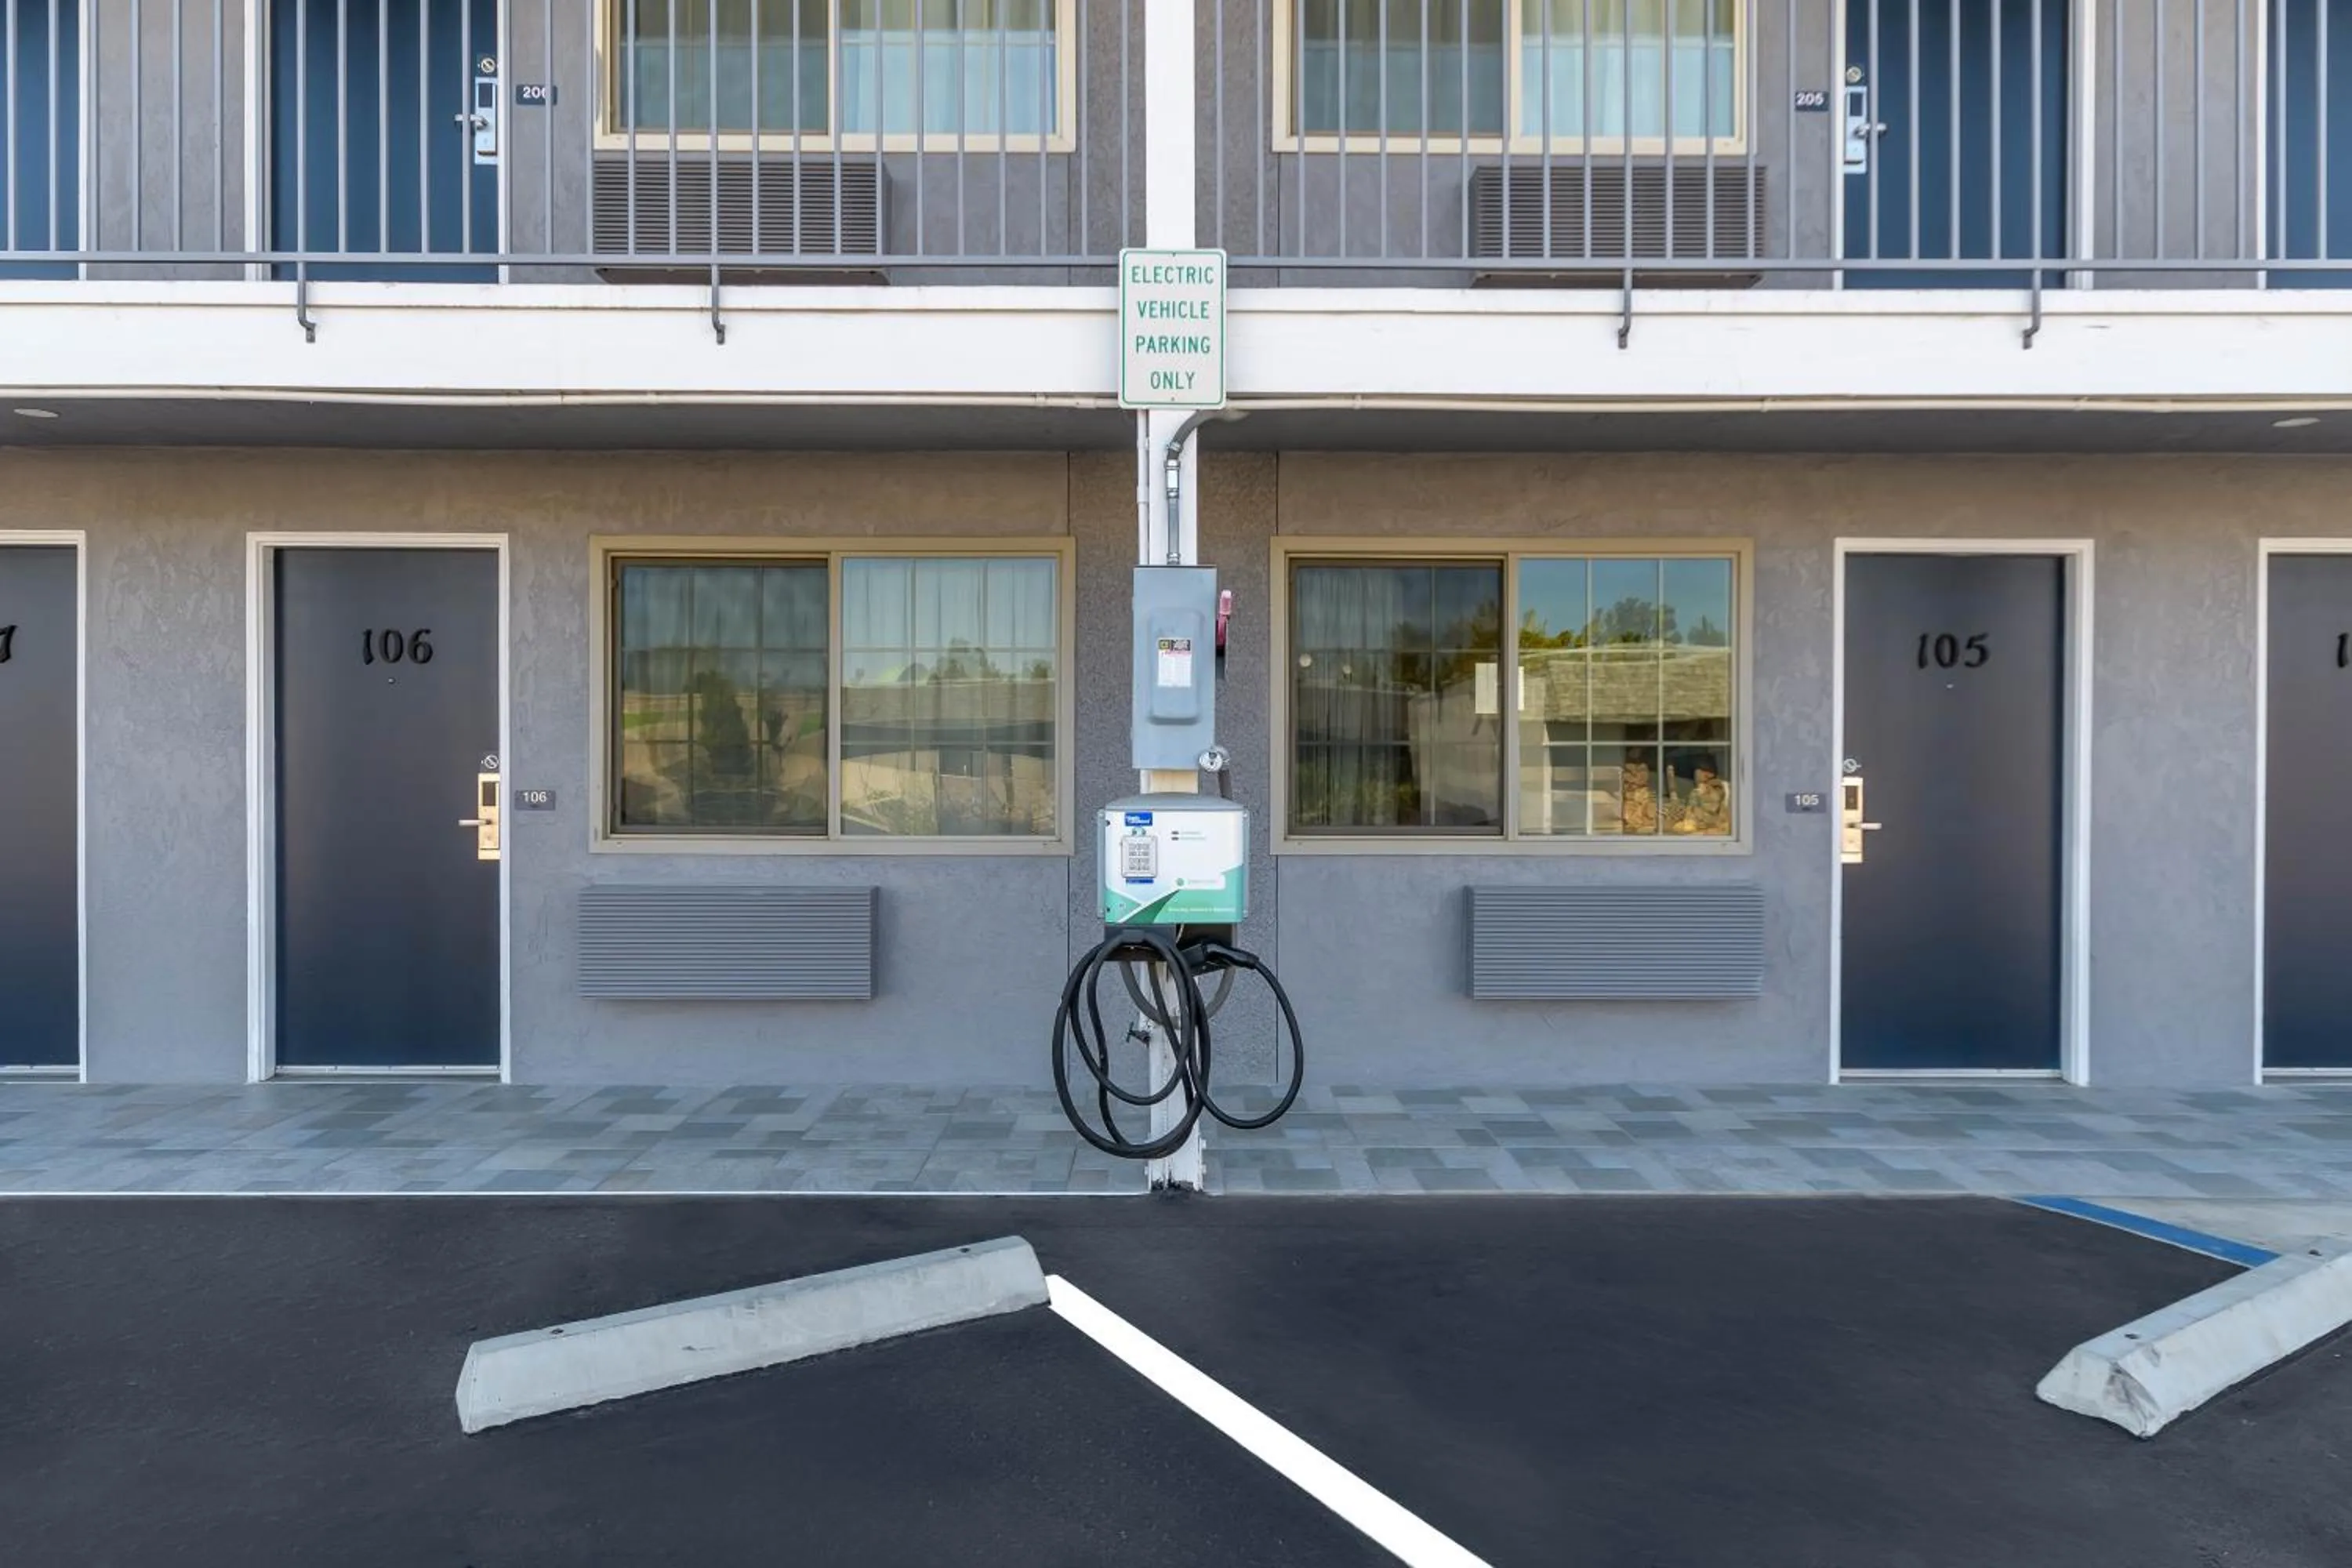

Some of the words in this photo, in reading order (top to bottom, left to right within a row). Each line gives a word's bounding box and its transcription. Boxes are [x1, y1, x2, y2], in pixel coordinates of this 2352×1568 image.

[1131, 265, 1214, 285] ELECTRIC
[1137, 300, 1210, 320] VEHICLE
[1135, 336, 1211, 354] PARKING
[1150, 371, 1196, 390] ONLY
[362, 628, 434, 665] 106
[1918, 632, 1991, 670] 105
[522, 791, 546, 804] 106
[1794, 793, 1819, 807] 105
